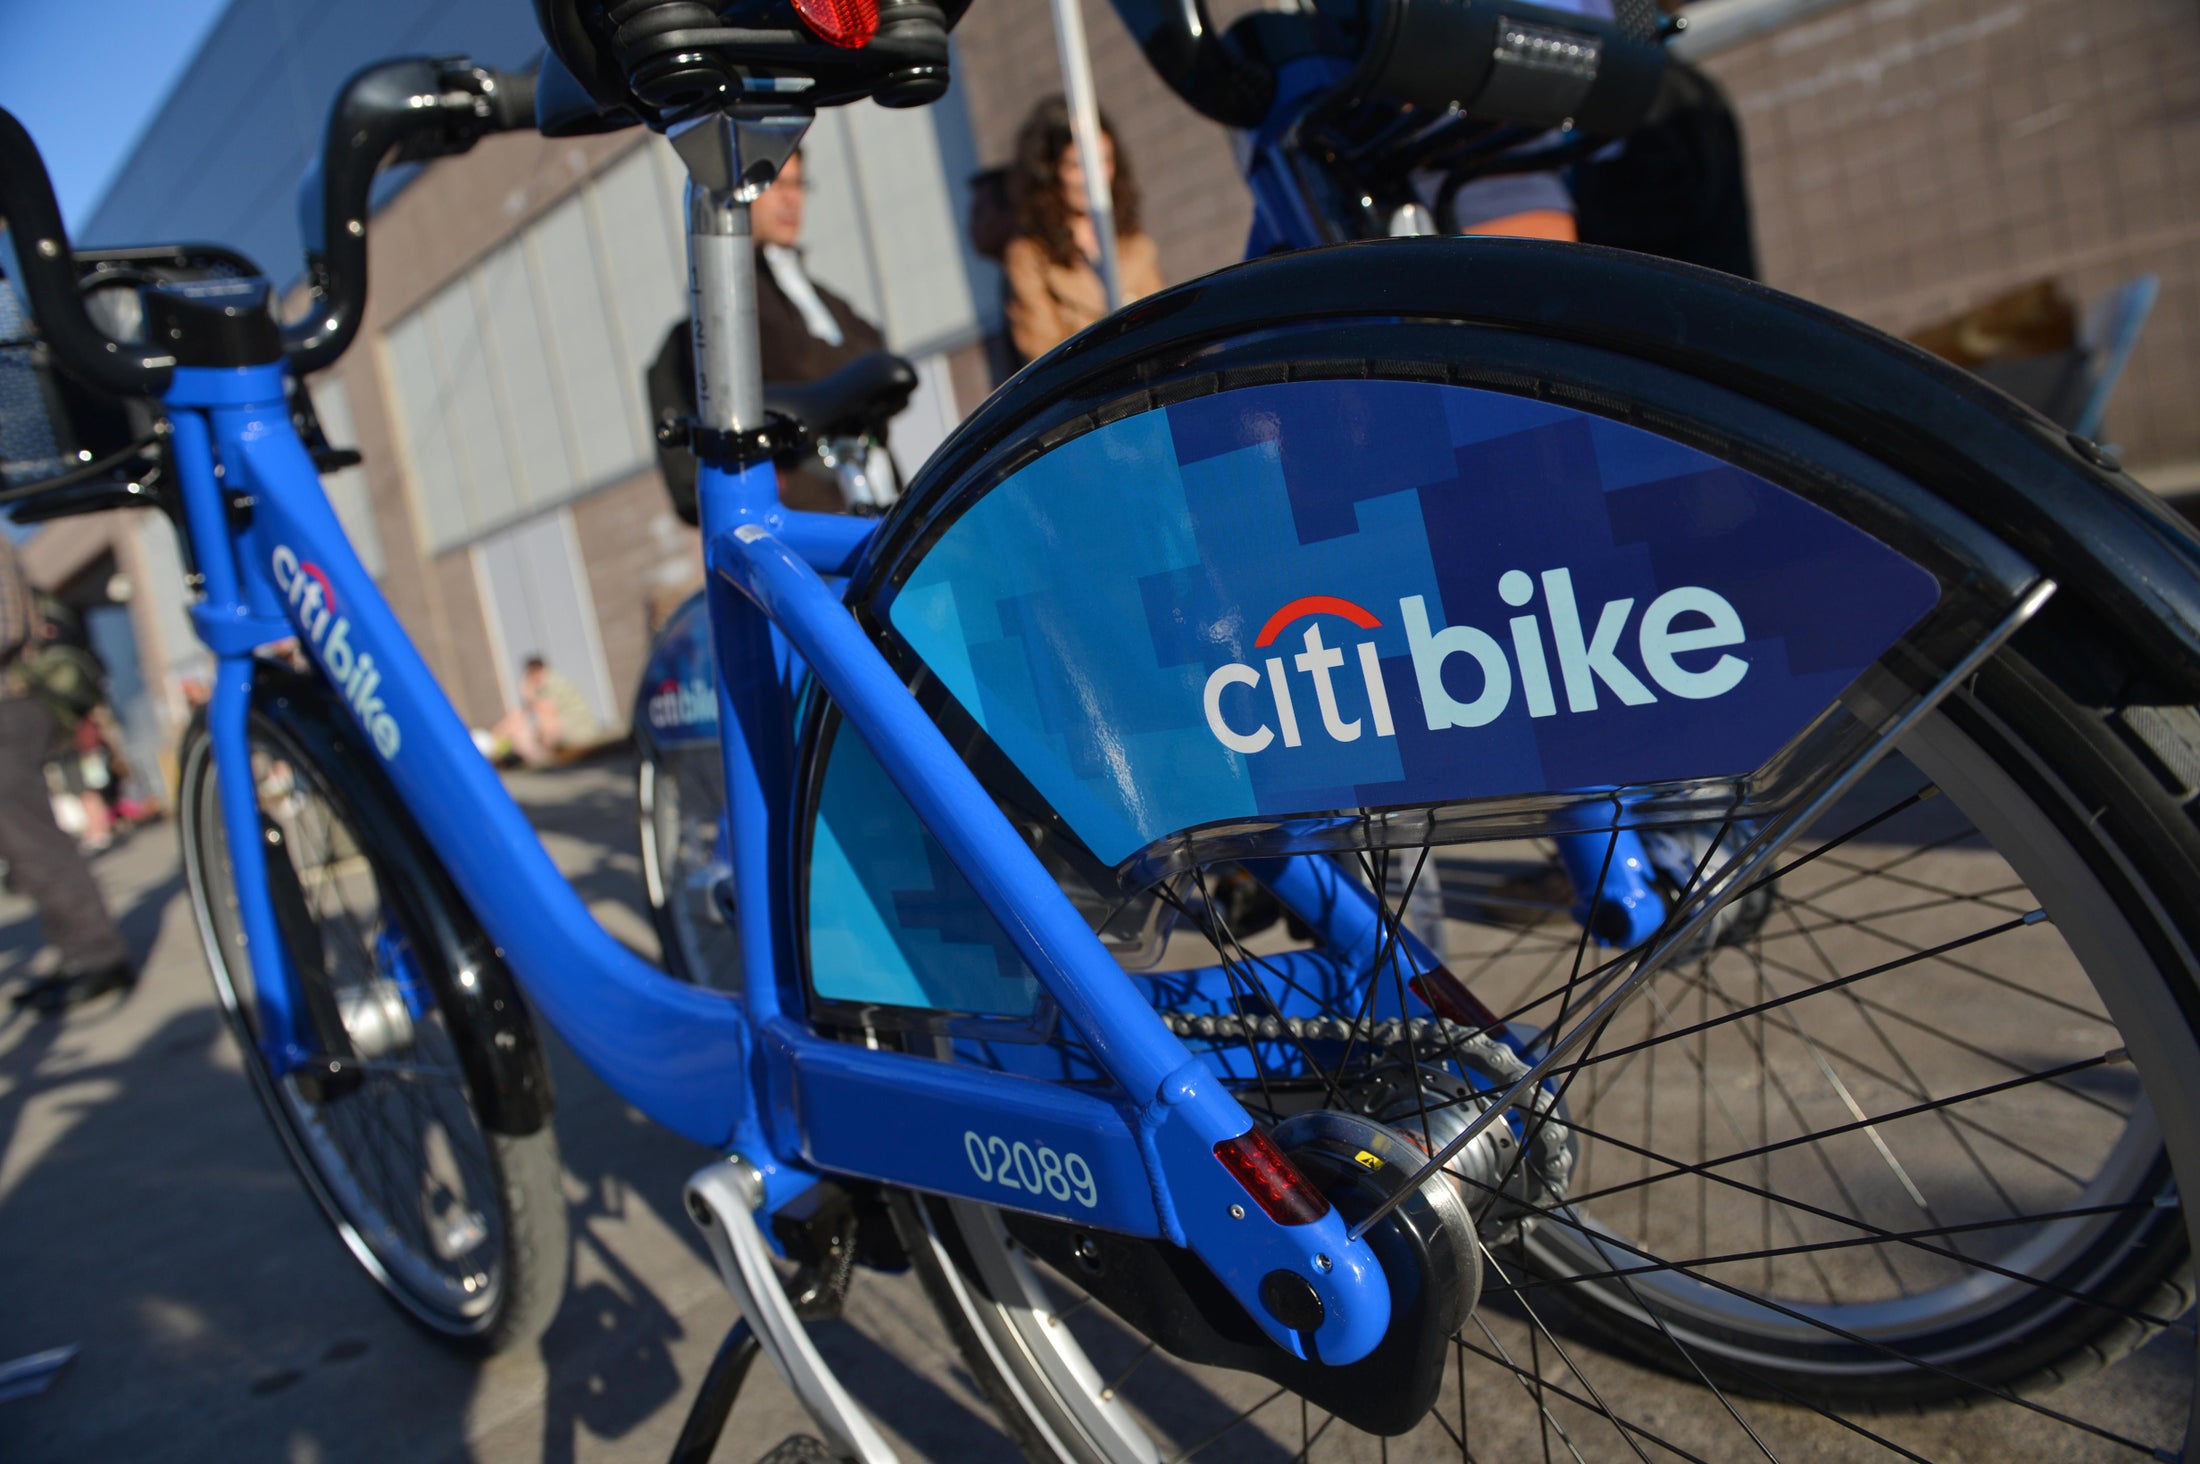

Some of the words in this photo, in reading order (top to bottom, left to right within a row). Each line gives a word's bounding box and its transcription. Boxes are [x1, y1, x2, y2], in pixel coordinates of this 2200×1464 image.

[272, 544, 336, 644] citi
[323, 616, 401, 762] bike
[1203, 595, 1397, 754] citi
[1399, 567, 1750, 731] bike
[964, 1130, 1098, 1208] 02089
